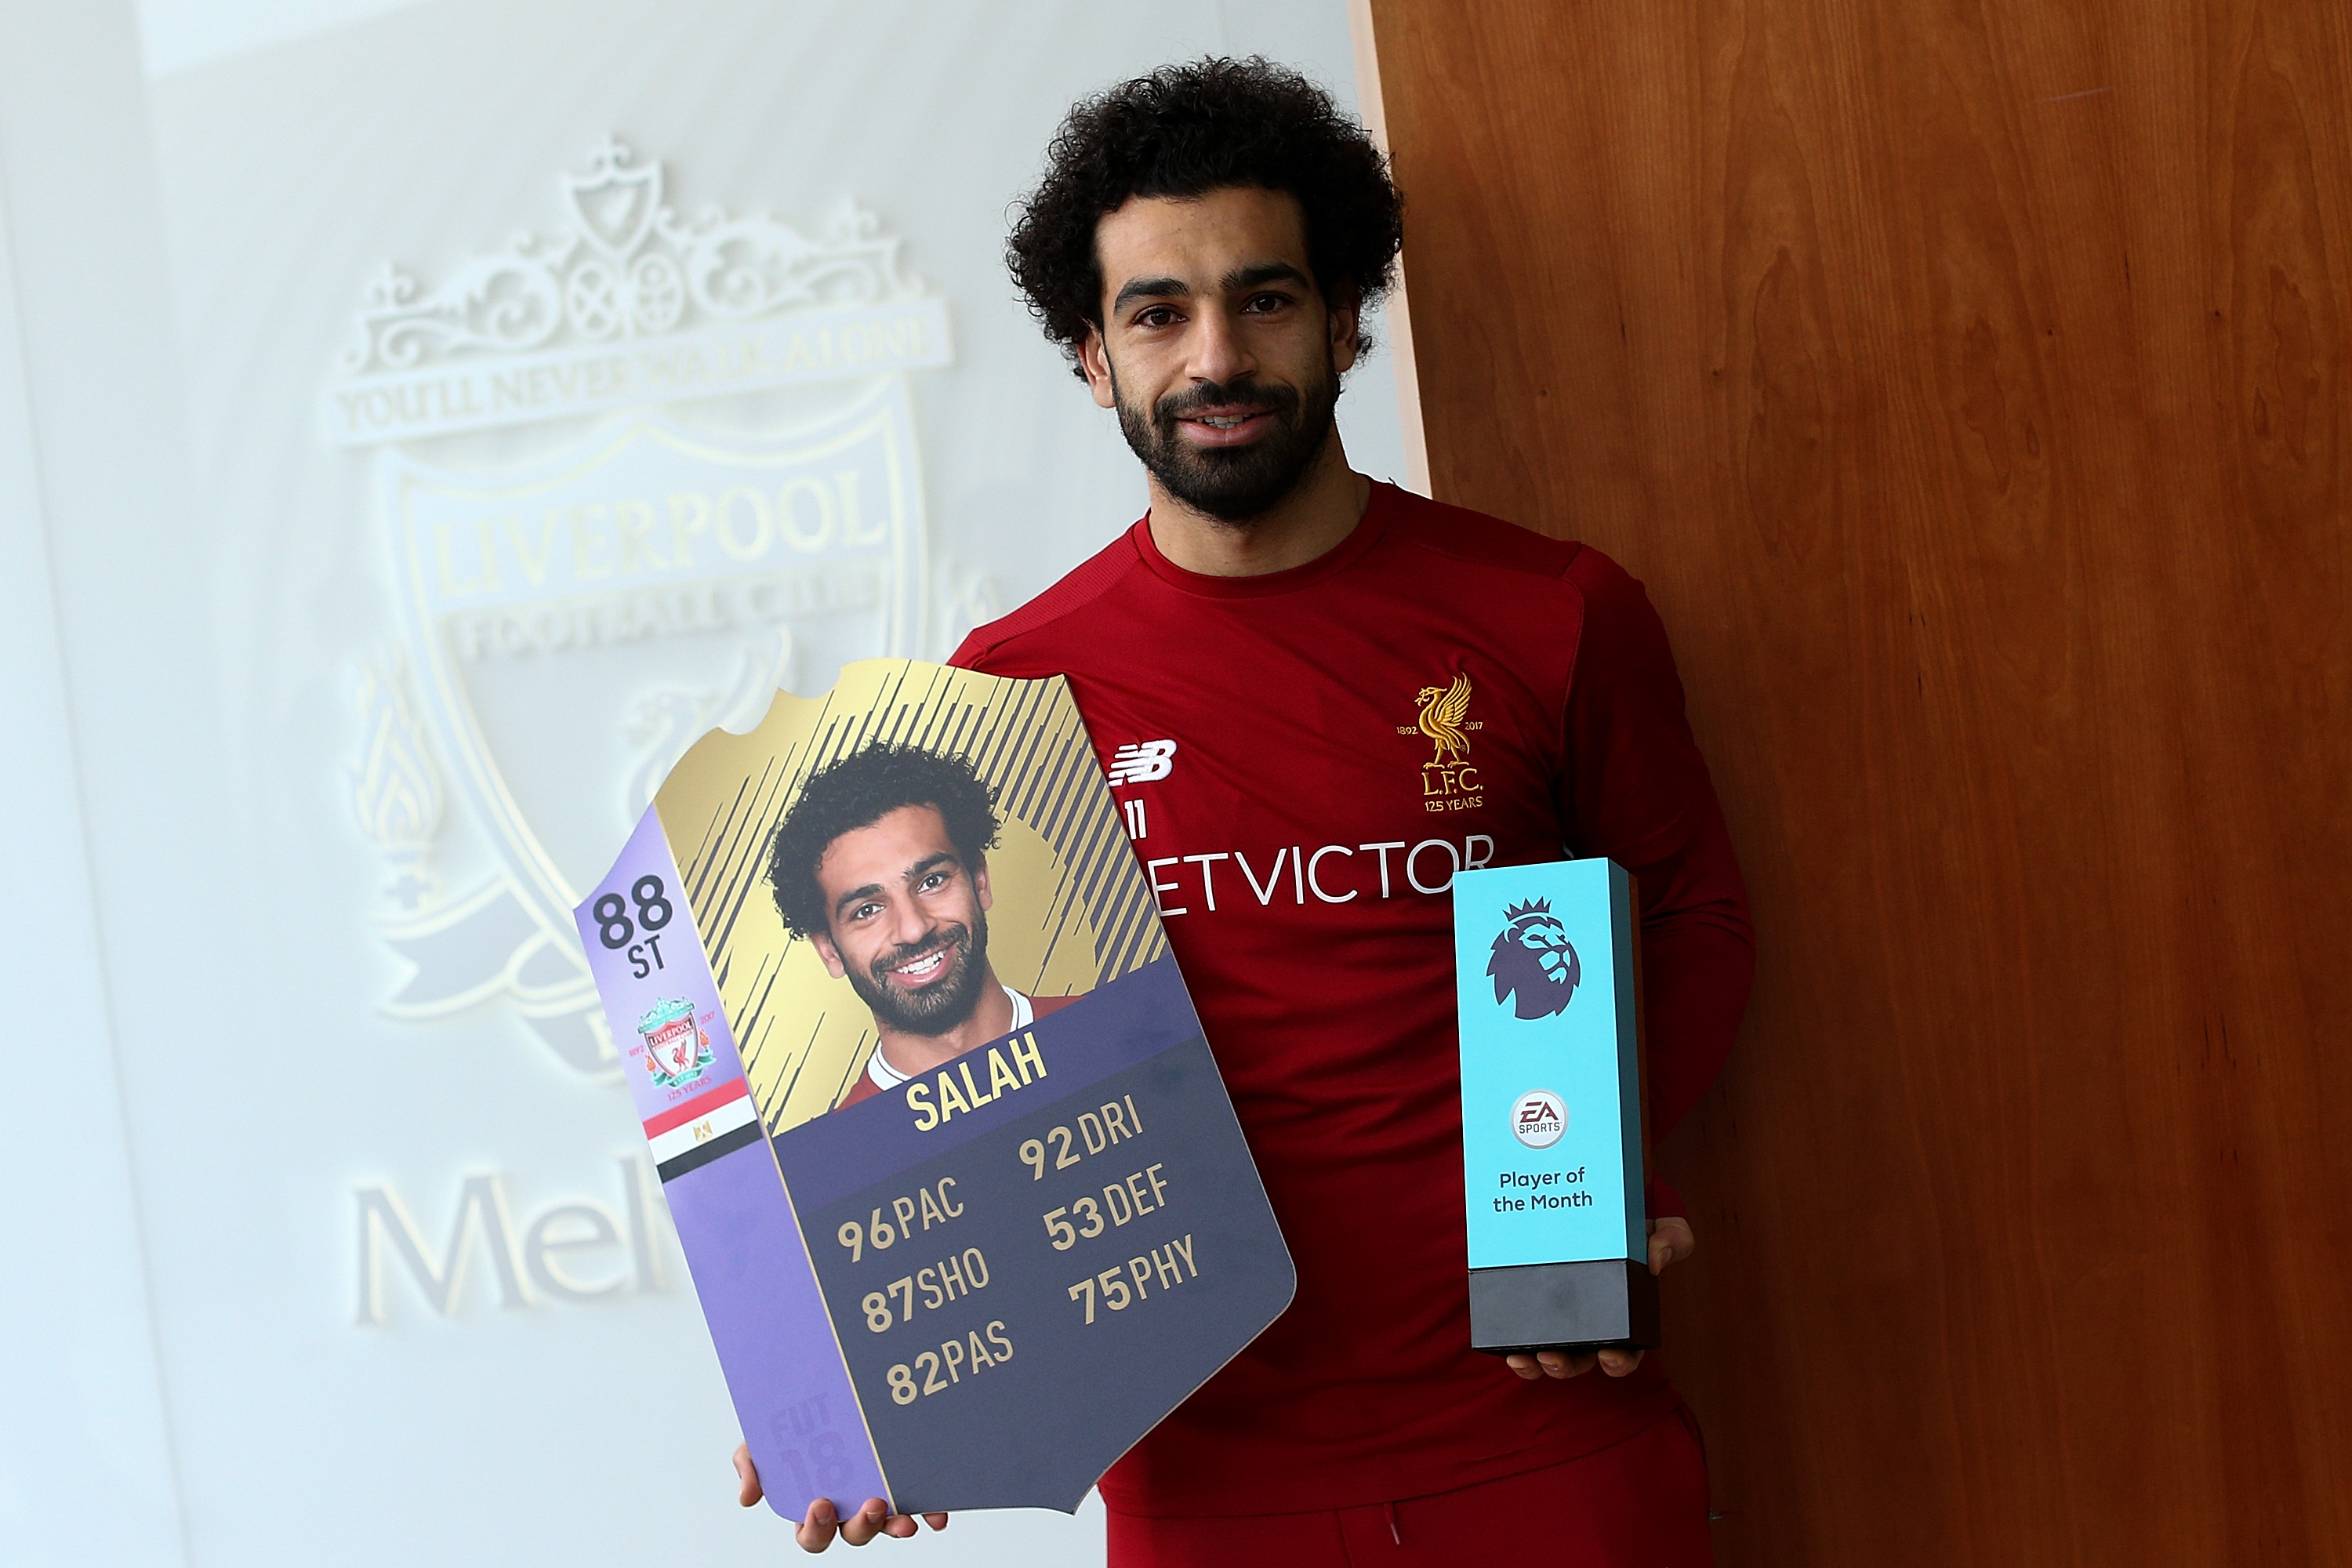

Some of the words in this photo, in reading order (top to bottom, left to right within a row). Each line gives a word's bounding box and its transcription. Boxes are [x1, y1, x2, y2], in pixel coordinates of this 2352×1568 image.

[491, 350, 635, 411] NEVER
[431, 469, 887, 598] LIVERPOOL
[1396, 726, 1418, 735] 1892
[1465, 721, 1483, 730] 2017
[1421, 768, 1484, 796] L.F.C.
[1425, 800, 1443, 811] 125
[1445, 796, 1483, 811] YEARS
[1124, 799, 1147, 840] 11
[593, 874, 673, 949] 88
[628, 934, 665, 979] ST
[650, 1021, 694, 1046] LIVERPOOL
[668, 1089, 682, 1101] 125
[683, 1075, 712, 1094] YEARS
[906, 1032, 1047, 1131] SALAH
[1519, 1102, 1559, 1123] EA
[1519, 1122, 1560, 1134] SPORTS
[1500, 1171, 1561, 1190] Player
[1566, 1167, 1585, 1183] of
[1494, 1196, 1525, 1212] the
[1531, 1191, 1592, 1210] Month
[352, 1151, 676, 1327] Mel
[770, 1392, 830, 1445] FUT
[780, 1431, 855, 1501] 18
